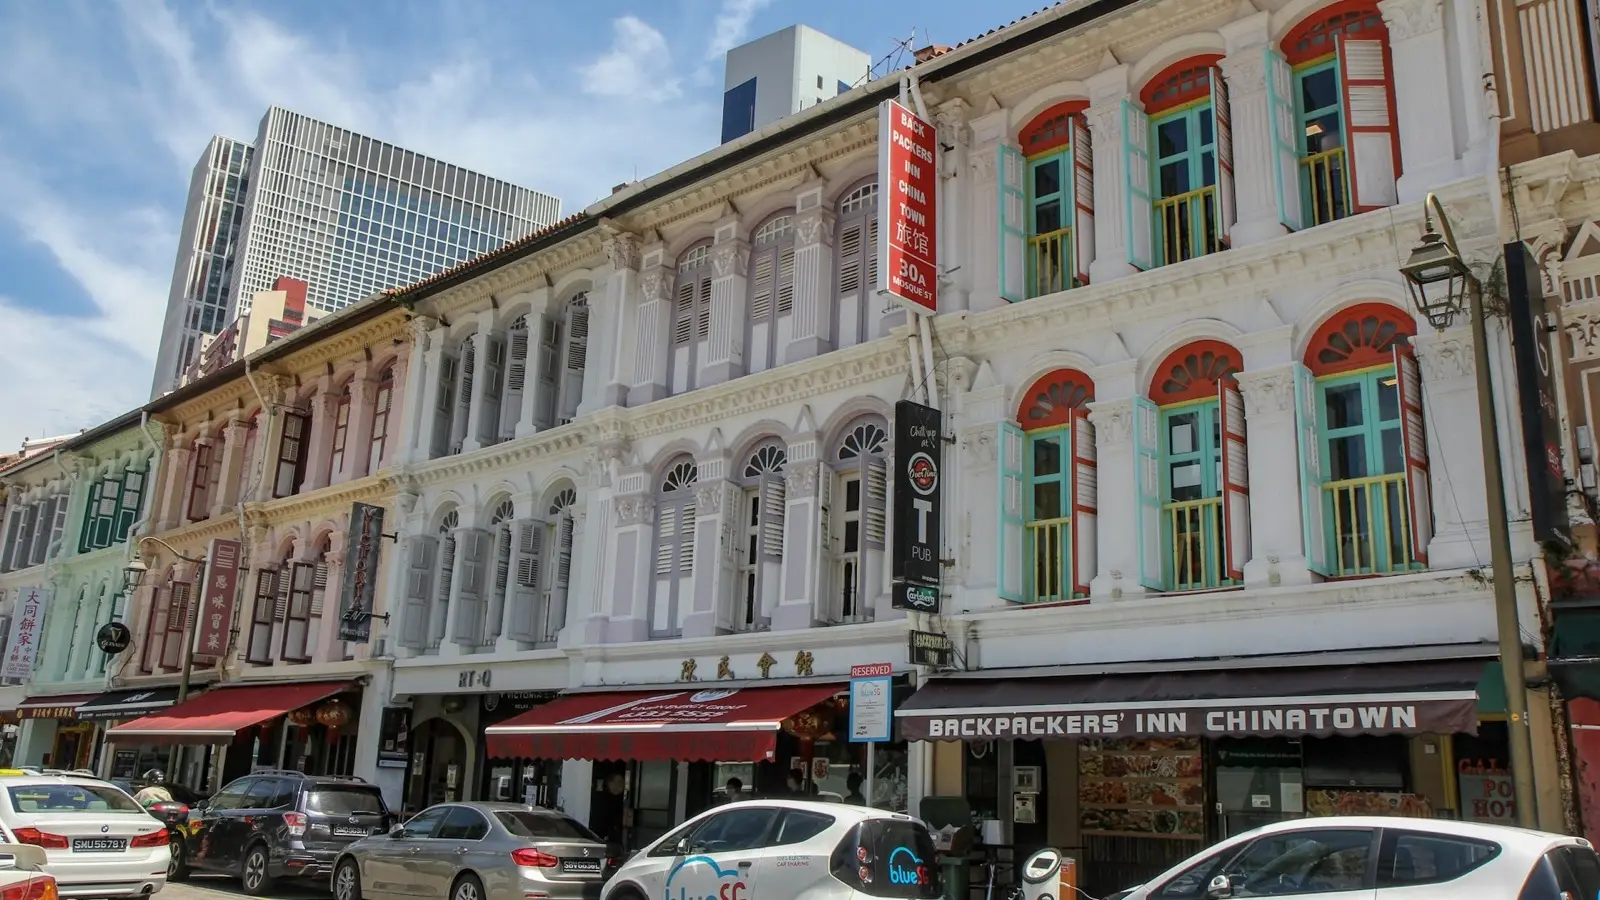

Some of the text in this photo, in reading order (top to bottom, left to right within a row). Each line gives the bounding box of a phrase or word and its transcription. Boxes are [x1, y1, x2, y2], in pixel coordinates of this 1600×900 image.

[901, 112, 925, 138] BACK
[893, 129, 933, 164] PACKERS
[905, 159, 920, 180] INN
[899, 179, 926, 205] CHINA
[900, 202, 925, 227] TOWN
[896, 219, 929, 256] 旅馆
[899, 258, 926, 287] 30A
[893, 275, 933, 301] MOSQUE ST
[913, 497, 932, 544] T
[912, 545, 931, 562] PUB
[906, 586, 935, 606] Carlsberg
[852, 665, 890, 677] RESERVED
[1135, 712, 1187, 733] INN
[1206, 705, 1416, 731] CHINATOWN
[74, 840, 126, 849] SMU5678Y
